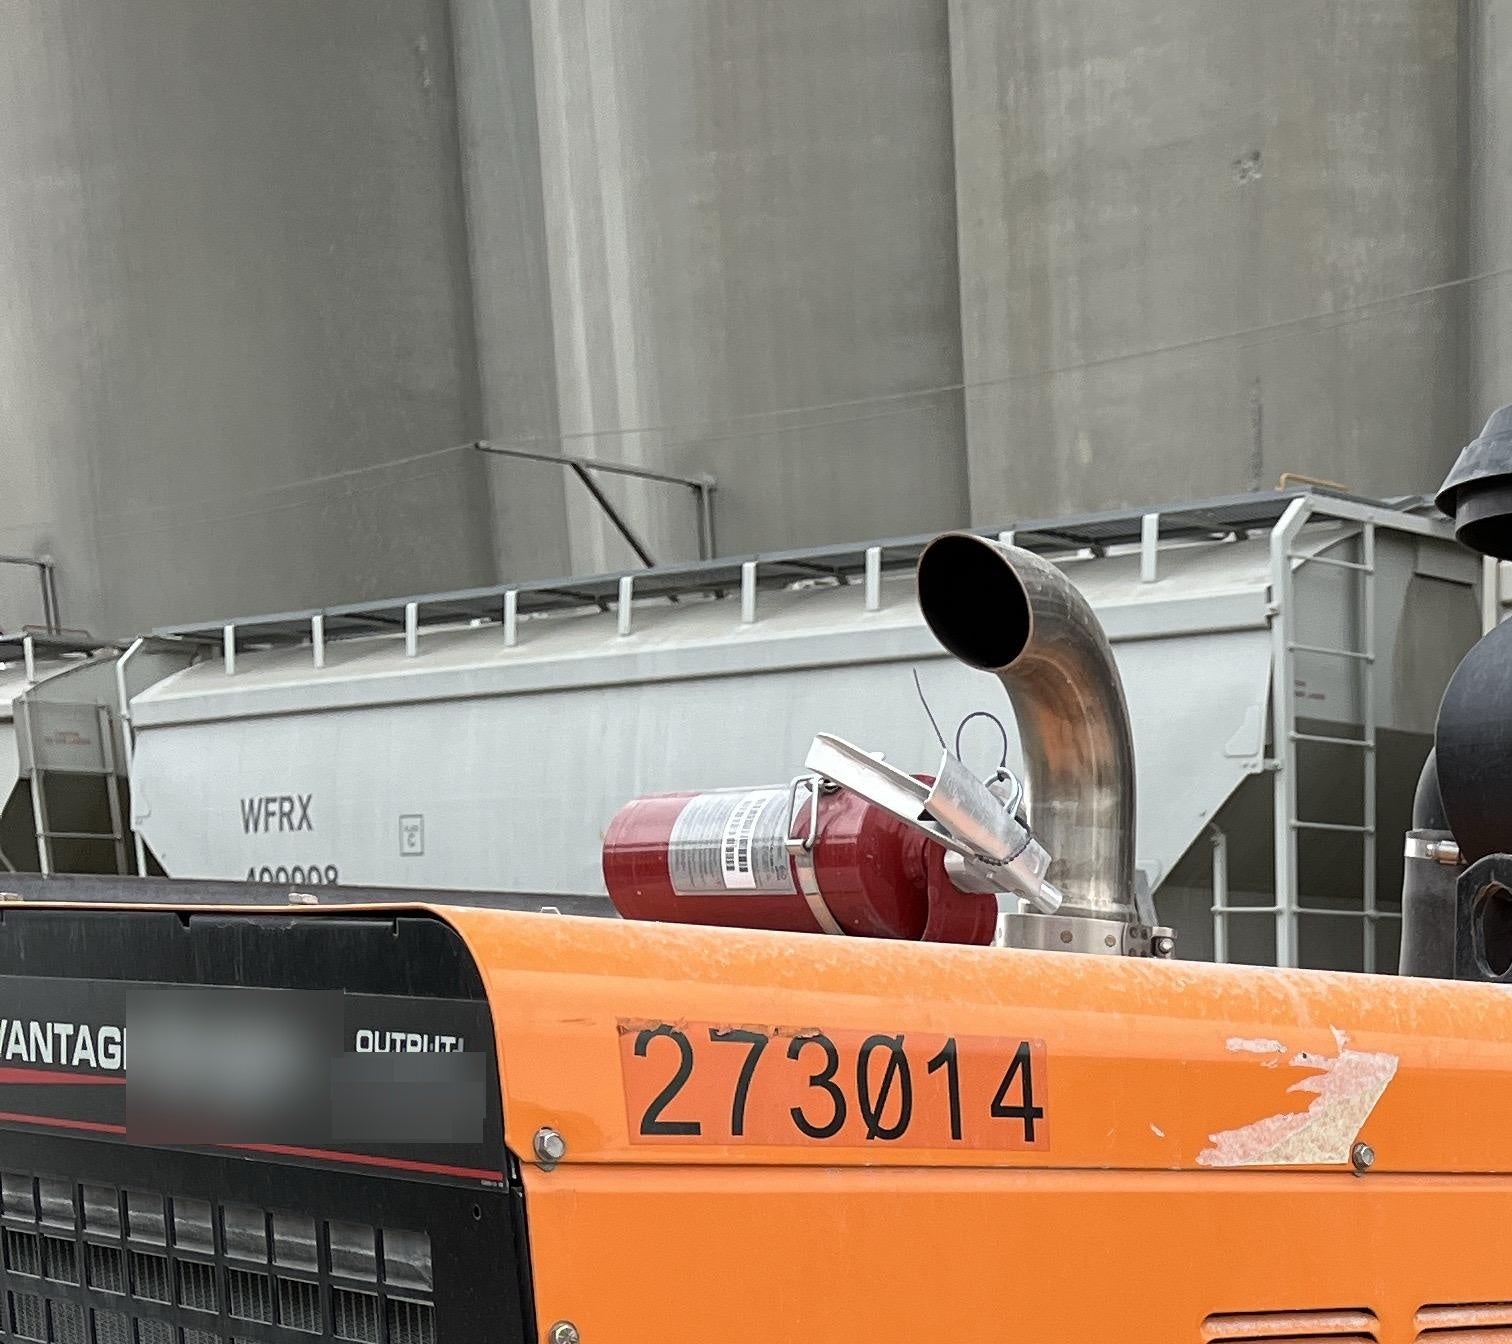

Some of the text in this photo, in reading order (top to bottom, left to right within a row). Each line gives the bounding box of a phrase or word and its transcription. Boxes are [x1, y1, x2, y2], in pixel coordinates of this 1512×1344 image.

[240, 794, 313, 834] WFRX
[0, 1019, 126, 1070] ANTAG
[633, 1023, 1044, 1142] 273014
